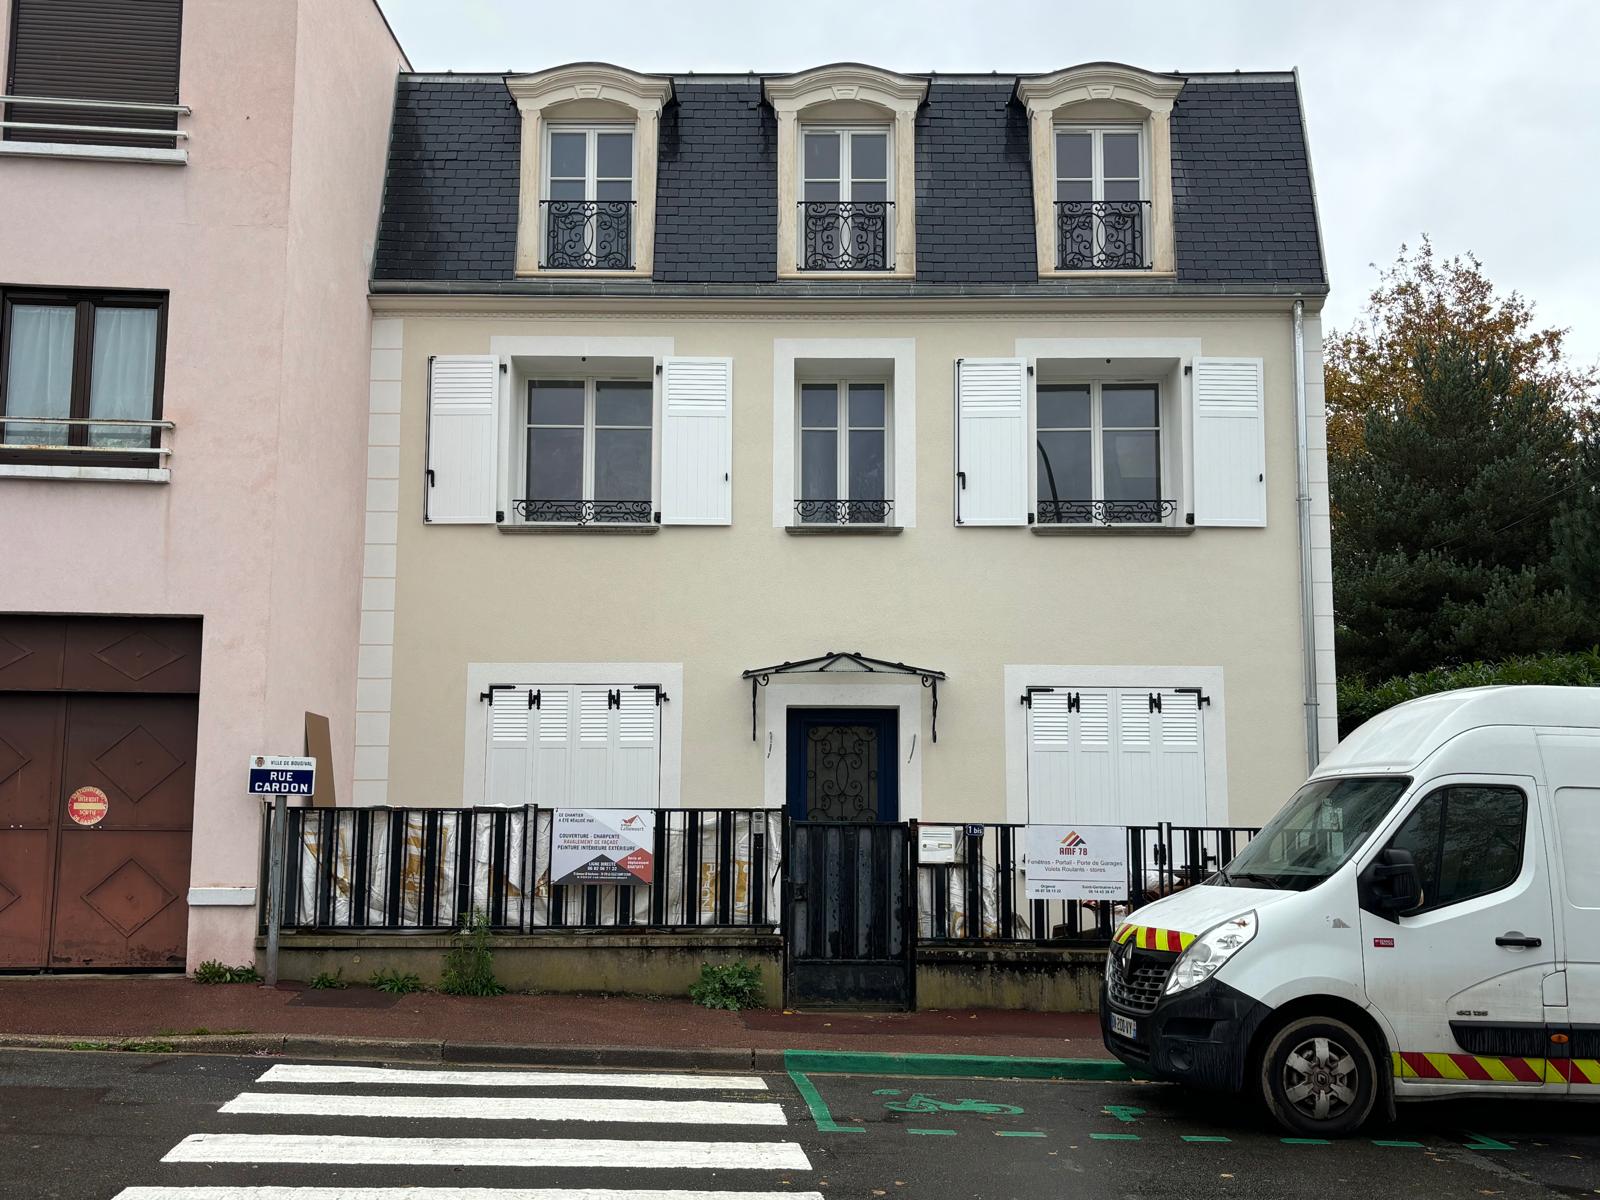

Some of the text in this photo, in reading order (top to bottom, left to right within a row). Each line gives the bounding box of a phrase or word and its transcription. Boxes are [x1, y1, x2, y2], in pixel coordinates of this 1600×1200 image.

[270, 771, 293, 781] RUE
[255, 782, 308, 793] CARDON
[973, 826, 982, 834] bis
[1059, 847, 1088, 856] AMF 78
